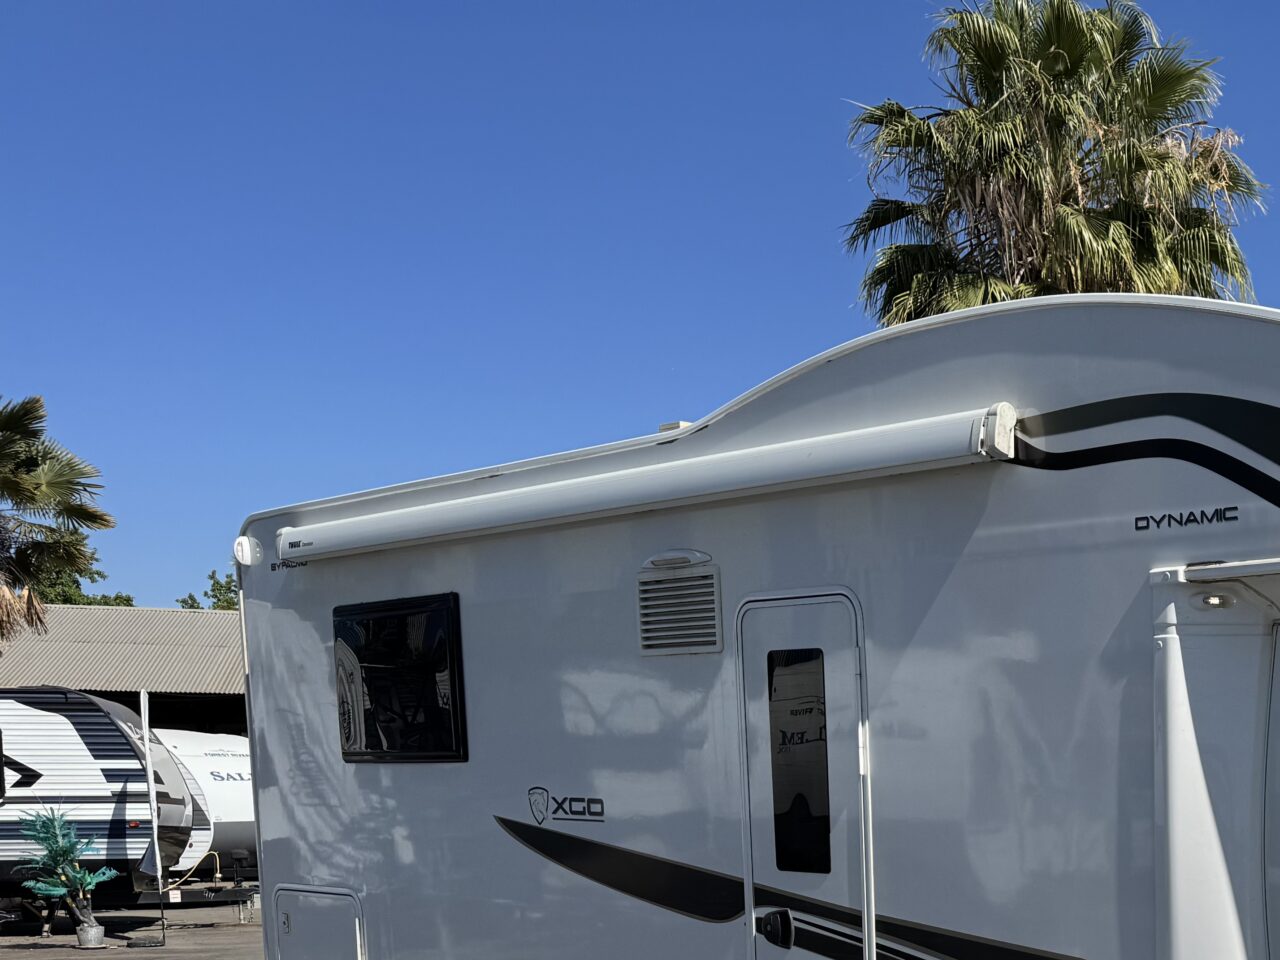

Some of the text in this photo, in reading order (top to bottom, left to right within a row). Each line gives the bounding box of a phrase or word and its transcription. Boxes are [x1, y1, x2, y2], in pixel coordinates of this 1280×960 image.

[1135, 506, 1239, 531] DYNAMIC
[209, 771, 252, 782] SAL
[551, 796, 605, 817] XGO
